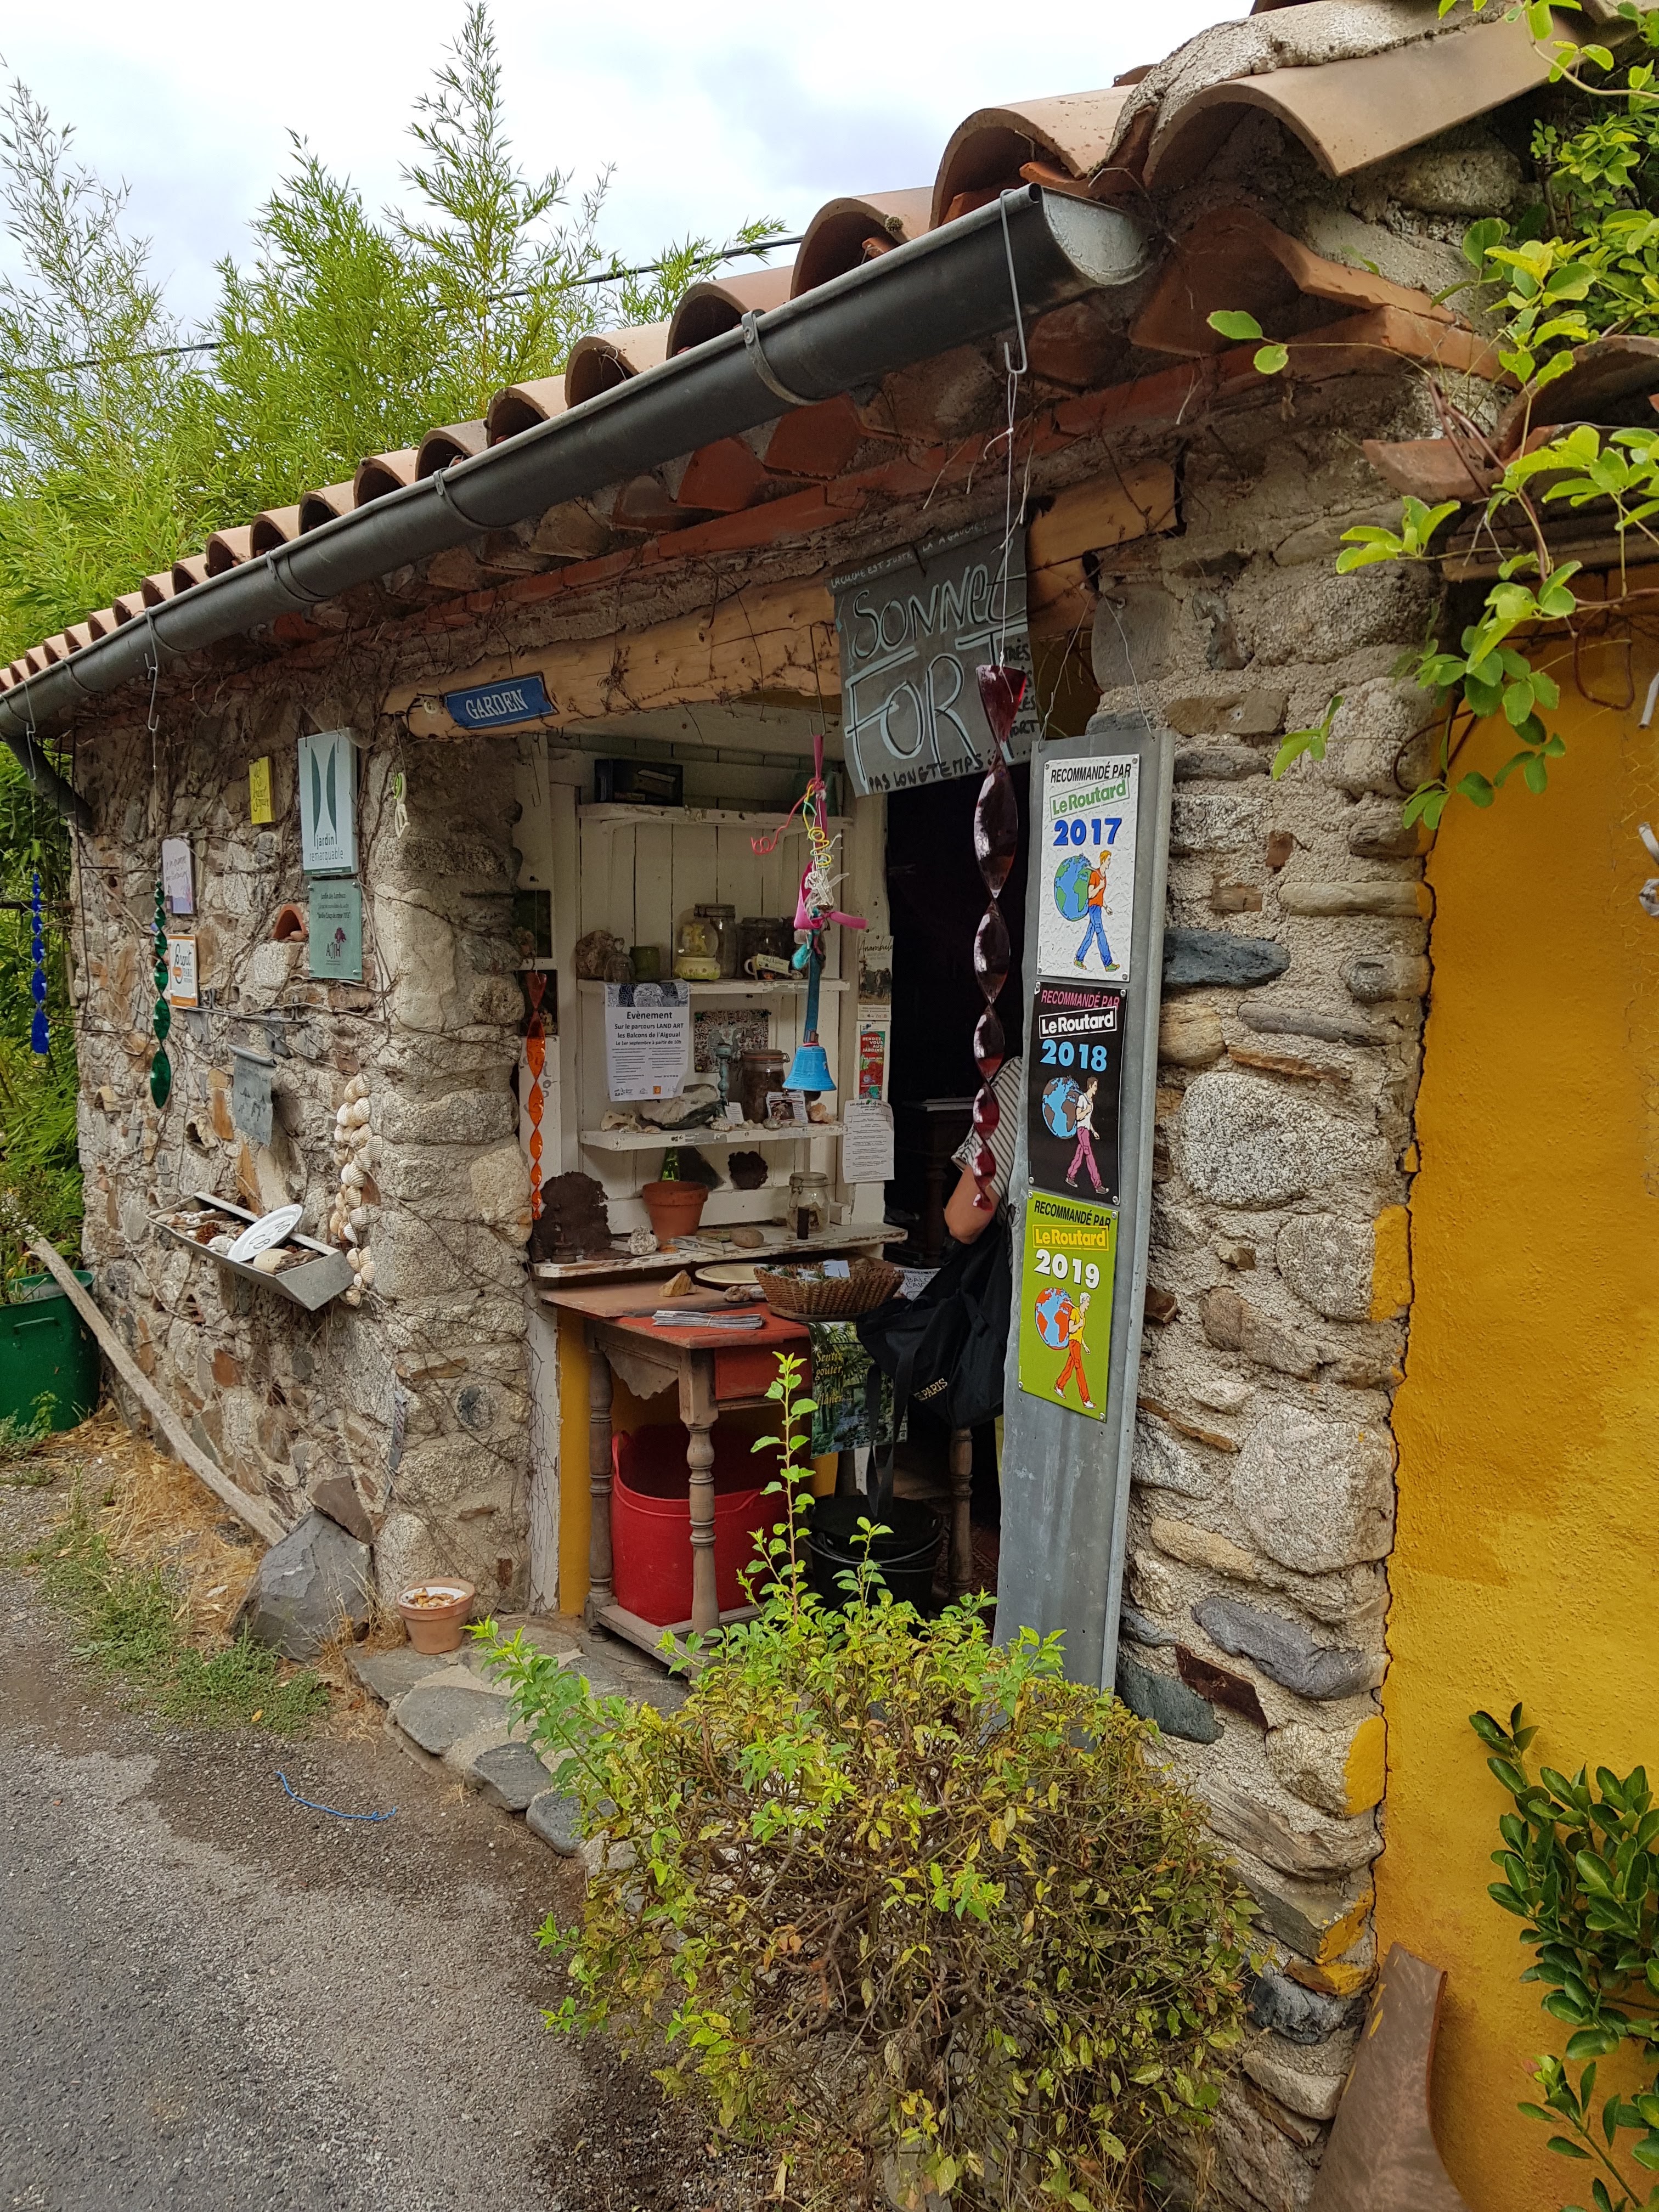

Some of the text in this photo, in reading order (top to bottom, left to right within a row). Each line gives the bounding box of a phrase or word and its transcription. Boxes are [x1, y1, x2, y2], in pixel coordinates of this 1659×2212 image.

[466, 689, 529, 720] GARDEN
[1050, 761, 1131, 783] RECOMMANDÉ PAR
[868, 773, 891, 794] PAS
[317, 833, 334, 850] jardin
[1053, 817, 1122, 847] 2017
[309, 847, 343, 862] remarquable
[1041, 989, 1120, 1011] RECOMMANDÉ PAR
[627, 1011, 673, 1019] Evènement
[1040, 1039, 1107, 1072] 2018
[1034, 1200, 1111, 1231] RECOMMANDÉ PAR
[1034, 1249, 1100, 1290] 2019
[921, 1378, 948, 1400] PARIS
